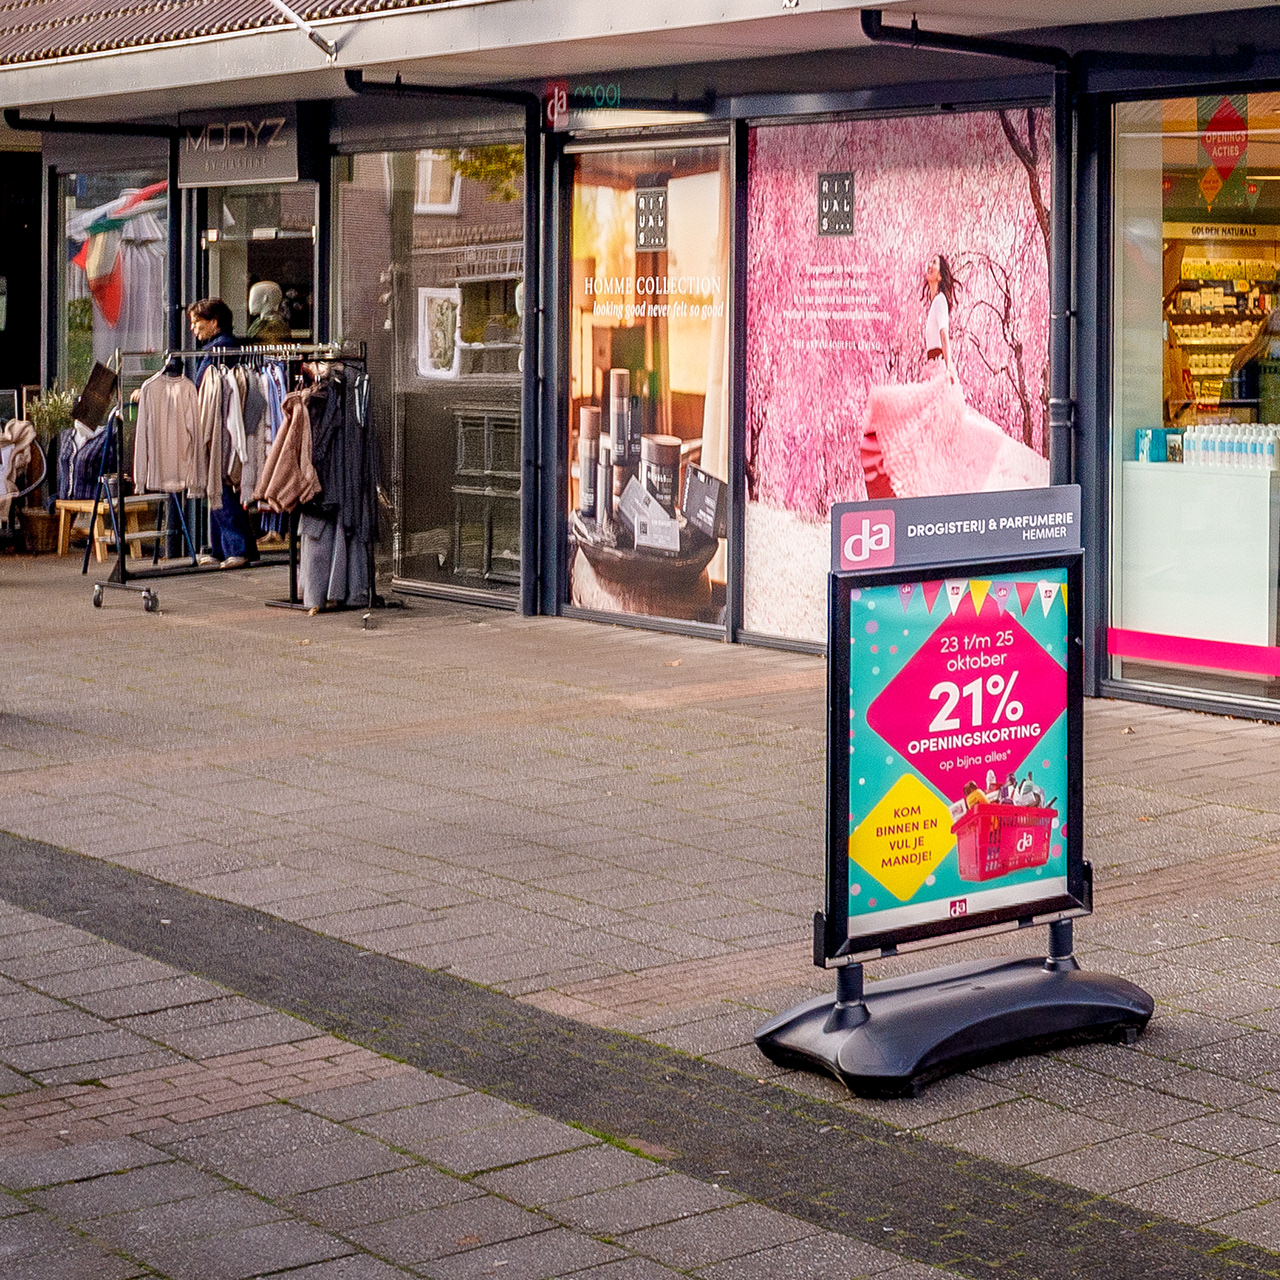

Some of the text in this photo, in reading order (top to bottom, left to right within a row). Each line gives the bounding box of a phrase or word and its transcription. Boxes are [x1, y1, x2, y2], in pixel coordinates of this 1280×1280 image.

[1205, 131, 1247, 143] OPENINGS
[1211, 146, 1240, 157] ACTIES
[1221, 227, 1257, 237] NATURALS
[584, 276, 721, 296] HOMME COLLECTION
[593, 300, 724, 321] looking good never felt so good
[907, 511, 1074, 538] DROGISTERIJ & PARFUMERIE
[1022, 526, 1068, 541] HEMMER
[843, 518, 890, 562] da
[940, 630, 1014, 653] 23 t/m 25
[946, 652, 1007, 672] oktober
[928, 670, 1024, 733] 21%
[907, 722, 1041, 755] OPENINGSKORTING
[939, 761, 954, 771] op
[956, 754, 983, 769] bijna
[893, 805, 922, 819] KOM
[876, 818, 938, 838] BINNEN EN
[889, 835, 925, 852] VUL JE
[1017, 832, 1033, 853] da
[881, 850, 932, 869] MANDJE!
